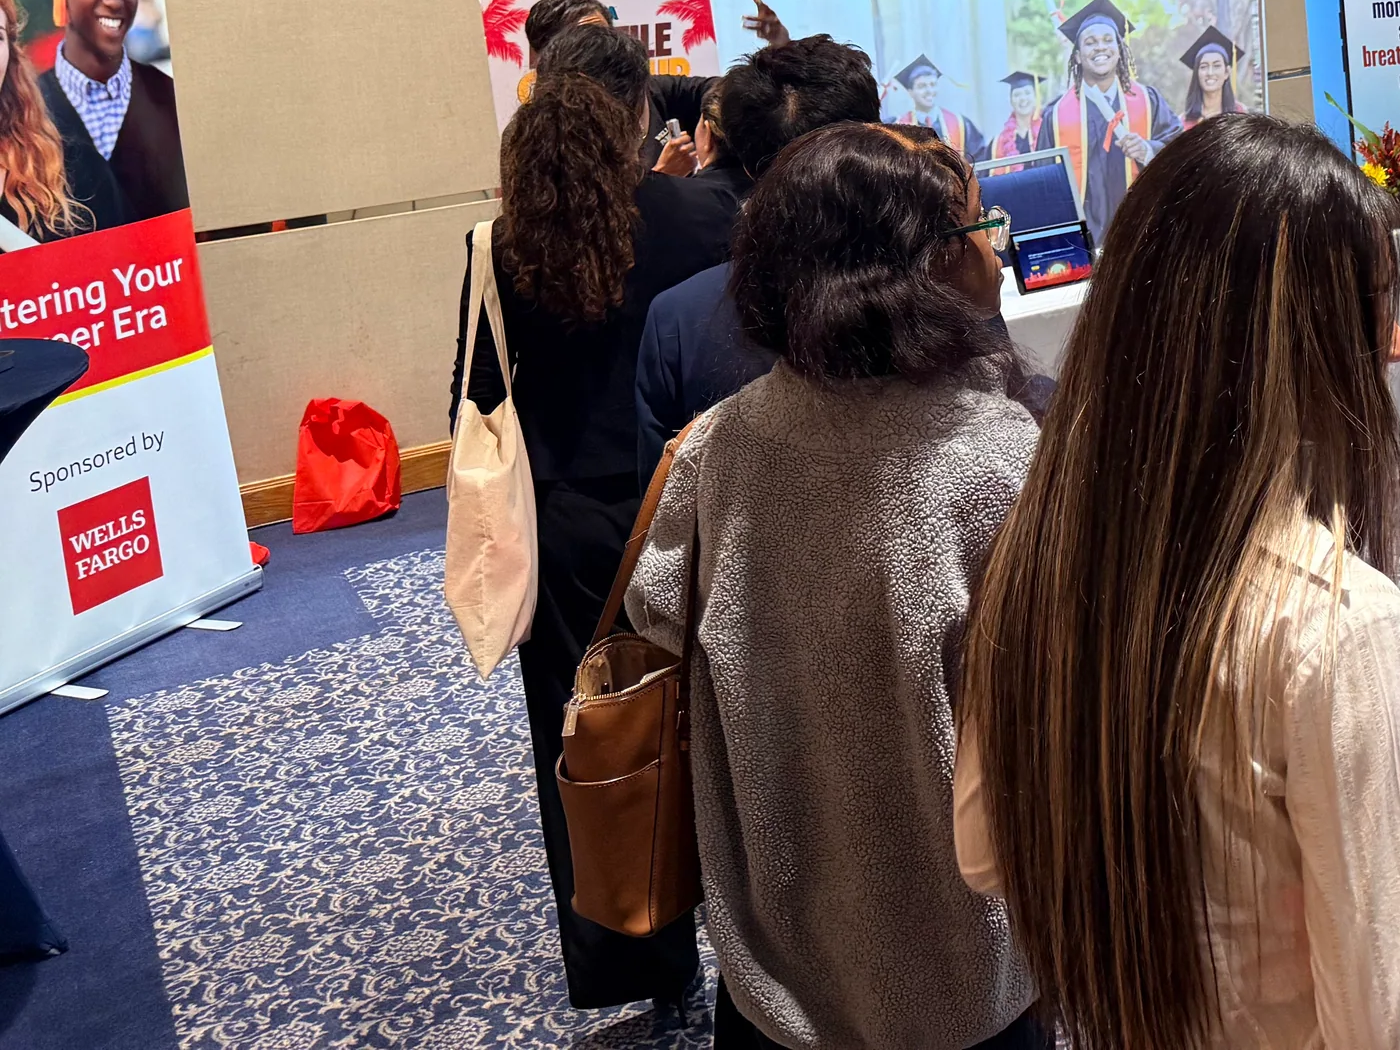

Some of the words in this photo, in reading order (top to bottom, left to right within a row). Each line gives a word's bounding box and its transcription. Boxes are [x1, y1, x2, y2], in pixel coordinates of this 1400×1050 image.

[0, 281, 106, 332] tering
[112, 258, 183, 297] Your
[113, 305, 167, 340] Era
[29, 436, 137, 493] Sponsored
[142, 431, 164, 452] by
[69, 509, 146, 554] WELLS
[75, 534, 150, 580] FARGO
